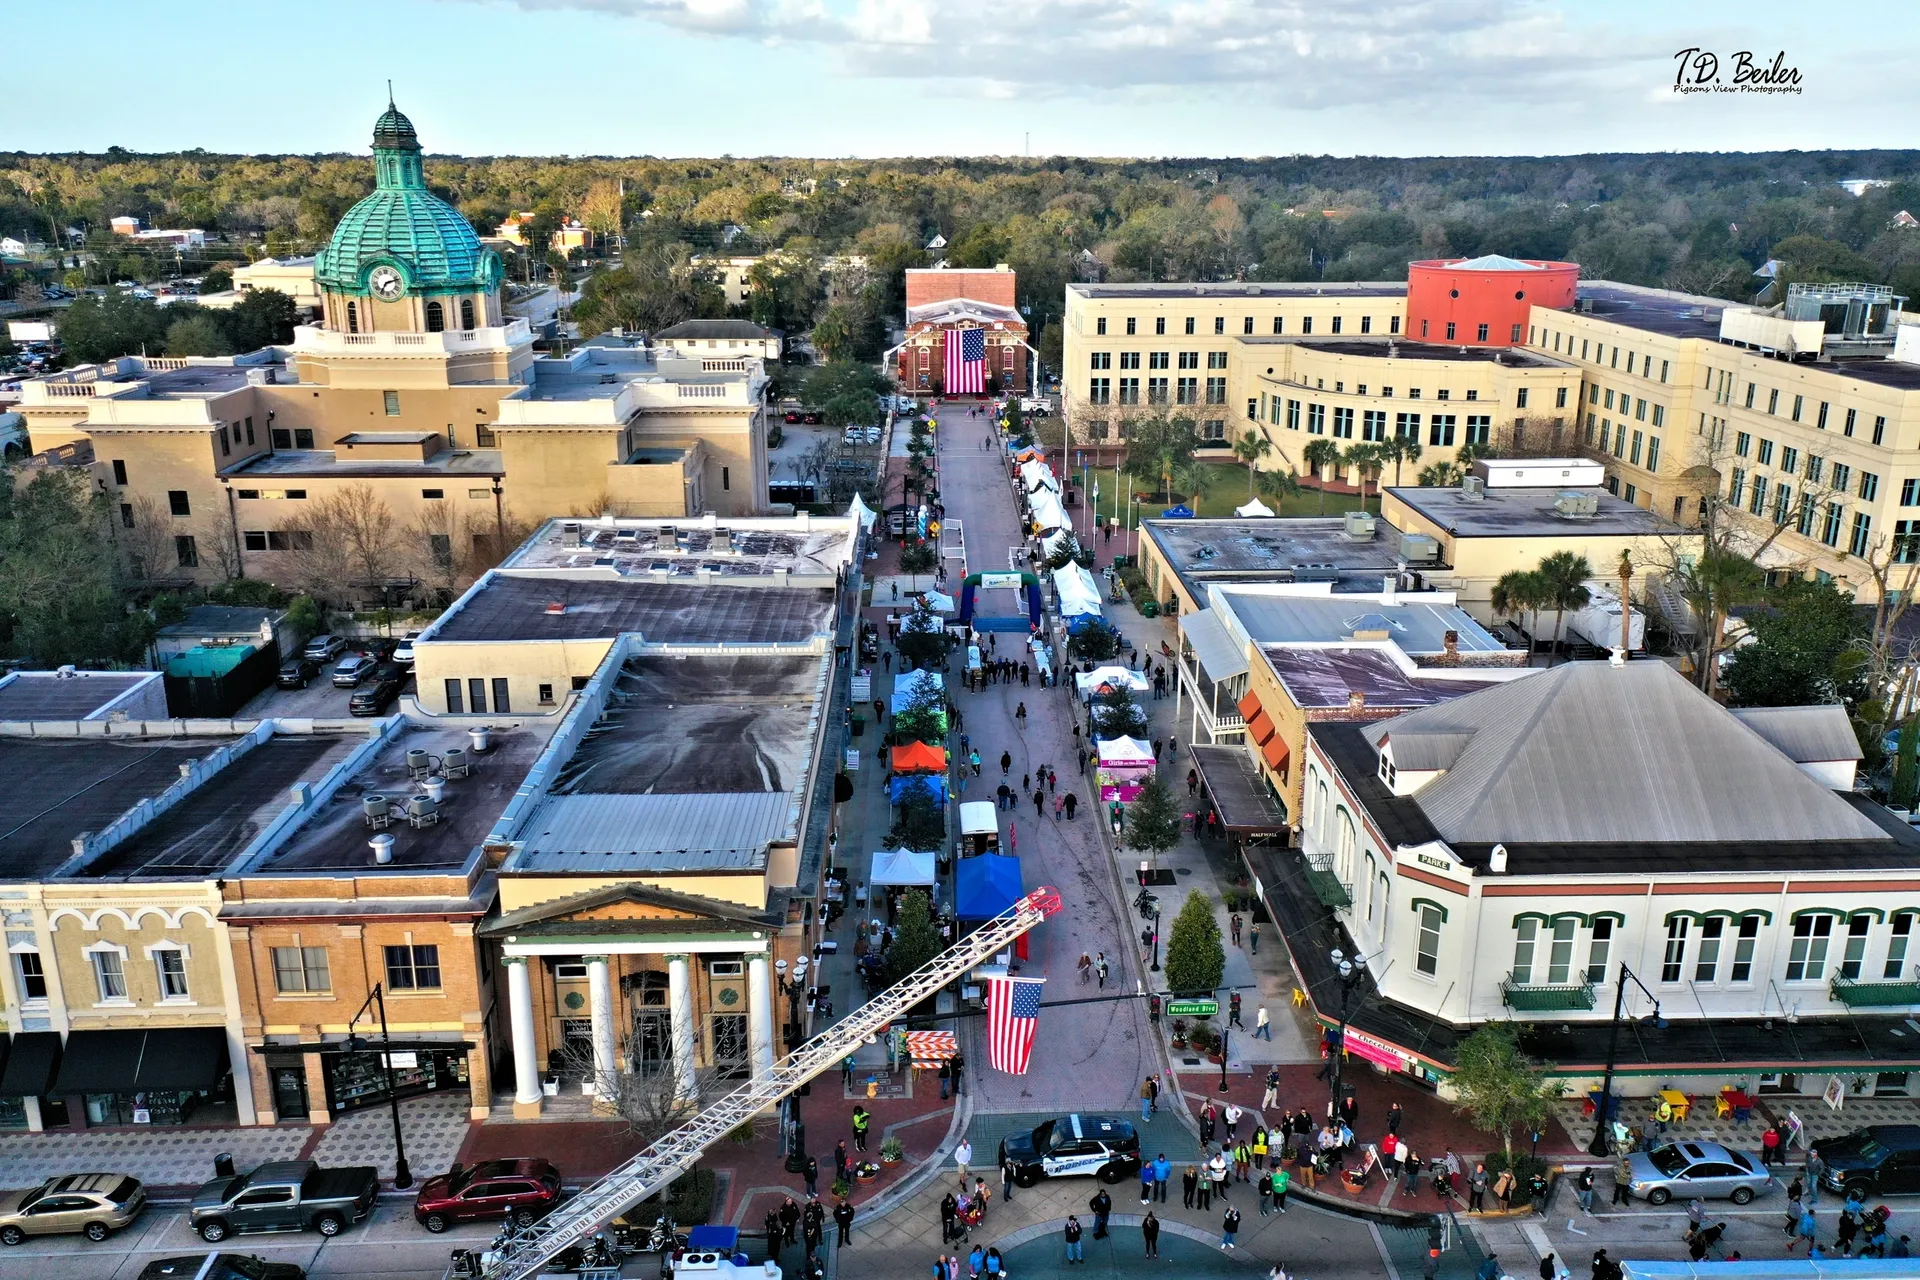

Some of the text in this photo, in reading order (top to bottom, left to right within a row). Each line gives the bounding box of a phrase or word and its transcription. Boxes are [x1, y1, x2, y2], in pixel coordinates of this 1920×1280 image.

[1422, 855, 1448, 869] PARKE
[1358, 1034, 1399, 1055] Chocolate
[1059, 1158, 1096, 1172] POLICE
[572, 1217, 592, 1232] FIRE
[592, 1184, 642, 1219] DEPARTMENT
